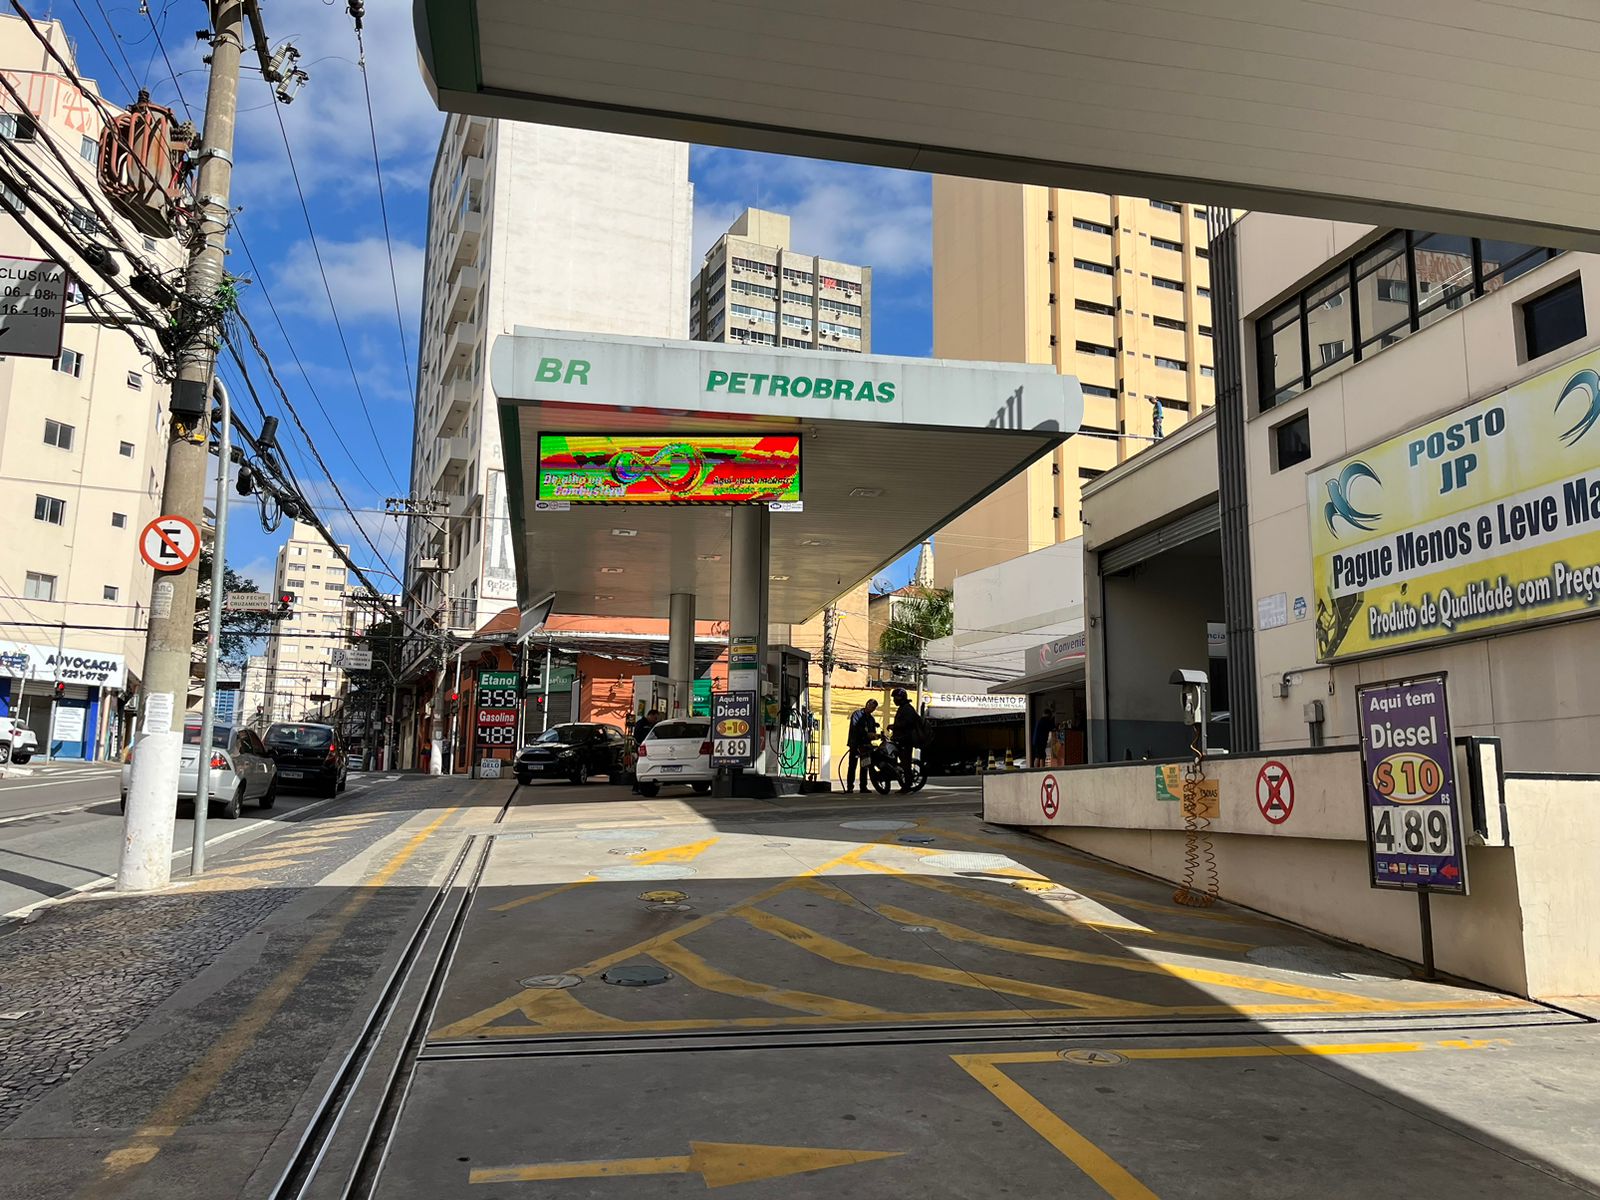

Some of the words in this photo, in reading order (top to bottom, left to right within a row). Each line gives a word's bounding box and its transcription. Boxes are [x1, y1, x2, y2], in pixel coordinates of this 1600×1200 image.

[0, 268, 61, 284] CLUSIVA
[4, 286, 20, 297] 06
[34, 288, 57, 301] 08h
[2, 304, 18, 315] 16
[33, 306, 55, 318] 19h
[534, 357, 591, 385] BR
[706, 370, 896, 403] PETROBRAS
[1408, 407, 1506, 467] POSTO
[1439, 453, 1478, 495] JP
[1332, 545, 1393, 590] Pague
[1396, 522, 1472, 572] Menos
[1477, 515, 1493, 550] e
[1497, 495, 1558, 546] Leve
[1562, 477, 1600, 526] Ma
[160, 528, 181, 559] E
[1368, 606, 1417, 636] Produto
[1420, 592, 1436, 625] de
[1439, 577, 1513, 628] Qualidade
[1517, 576, 1551, 605] com
[1554, 562, 1600, 601] Preço
[46, 655, 118, 672] ADVOCACIA
[481, 674, 517, 686] Etanol
[718, 696, 735, 704] Aqui
[940, 694, 1016, 704] ESTACIONAMENTO
[1370, 694, 1401, 712] Aqui
[1405, 692, 1436, 706] tem
[480, 711, 515, 723] Gasolina
[716, 704, 750, 717] Diesel
[1370, 716, 1438, 749] Diesel
